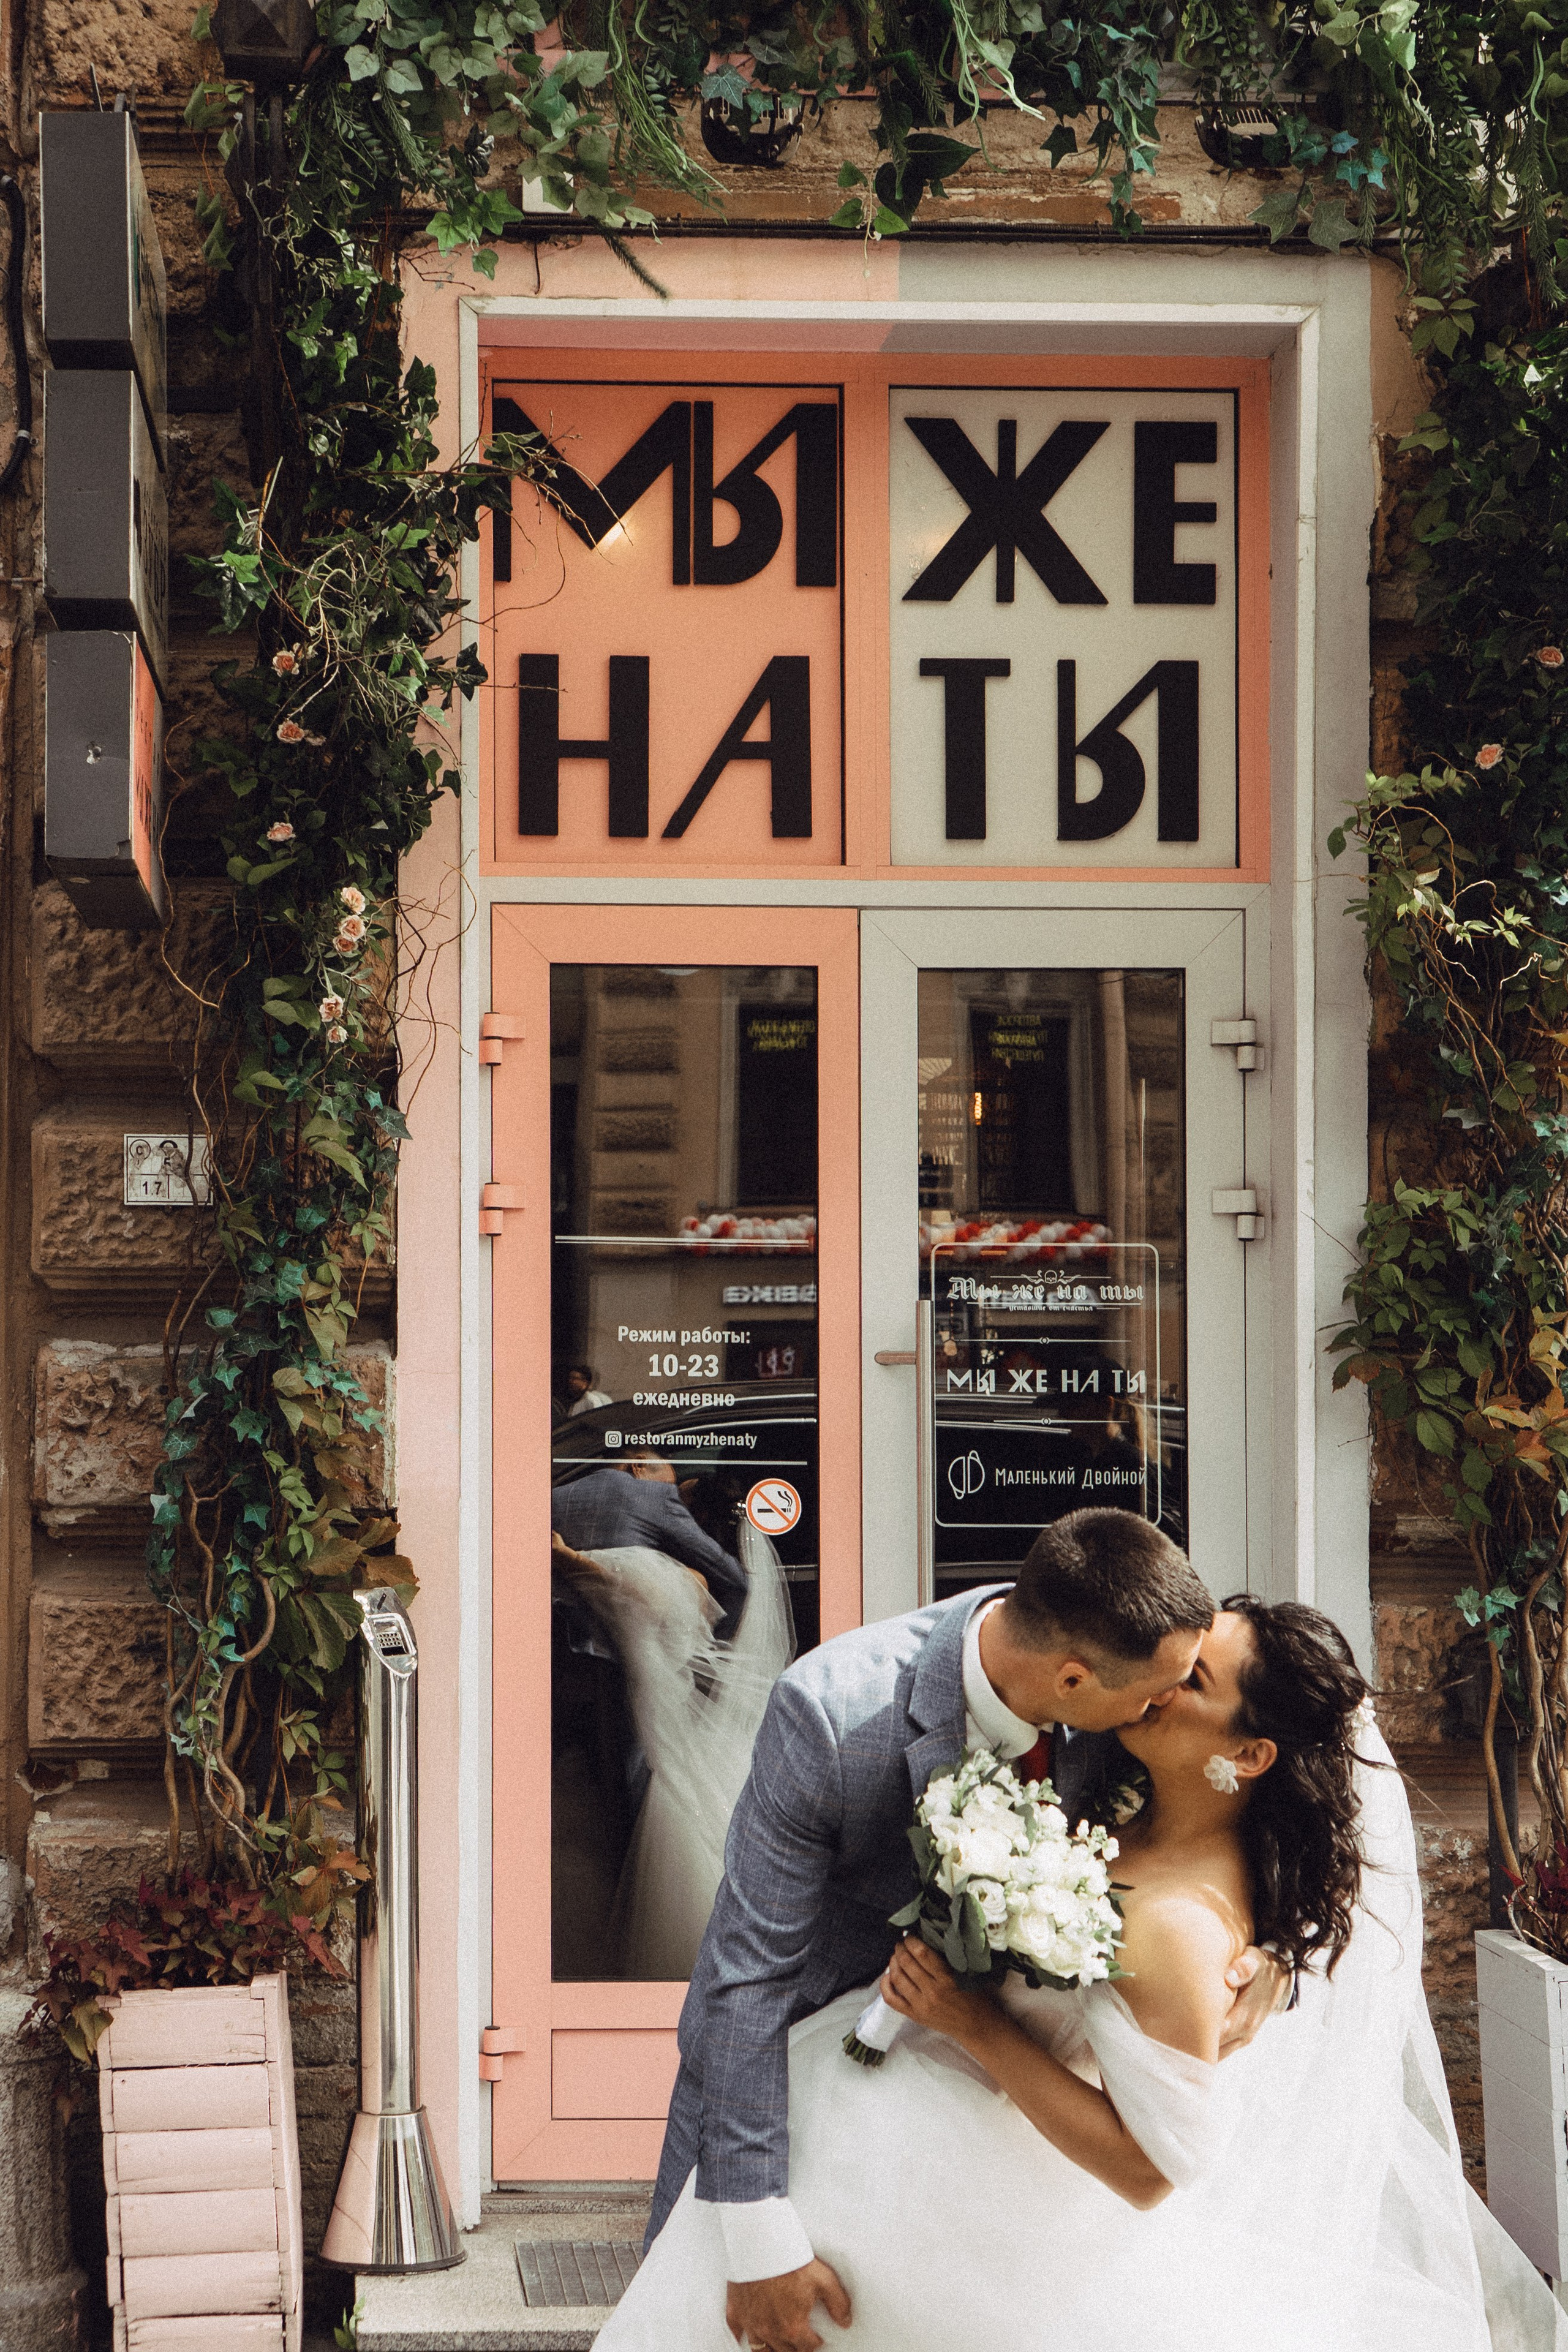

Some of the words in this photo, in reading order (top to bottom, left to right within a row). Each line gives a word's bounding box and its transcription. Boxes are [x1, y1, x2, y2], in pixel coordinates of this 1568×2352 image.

[492, 397, 838, 587] МЫ
[902, 417, 1218, 606] ЖЕ
[517, 653, 813, 839] НА
[919, 658, 1200, 842] ТЫ
[1012, 1284, 1045, 1300] же
[1056, 1284, 1088, 1300] на
[1100, 1284, 1144, 1300] ты
[618, 1325, 676, 1343] Режим
[681, 1327, 750, 1346] работы:
[649, 1354, 719, 1378] 10-23
[947, 1369, 995, 1393] МЫ
[1008, 1369, 1047, 1393] ЖЕ
[1061, 1370, 1099, 1393] НА
[1112, 1370, 1145, 1393] ТЫ
[633, 1392, 736, 1408] ежедневно
[624, 1431, 758, 1449] restoranmyzhenaty
